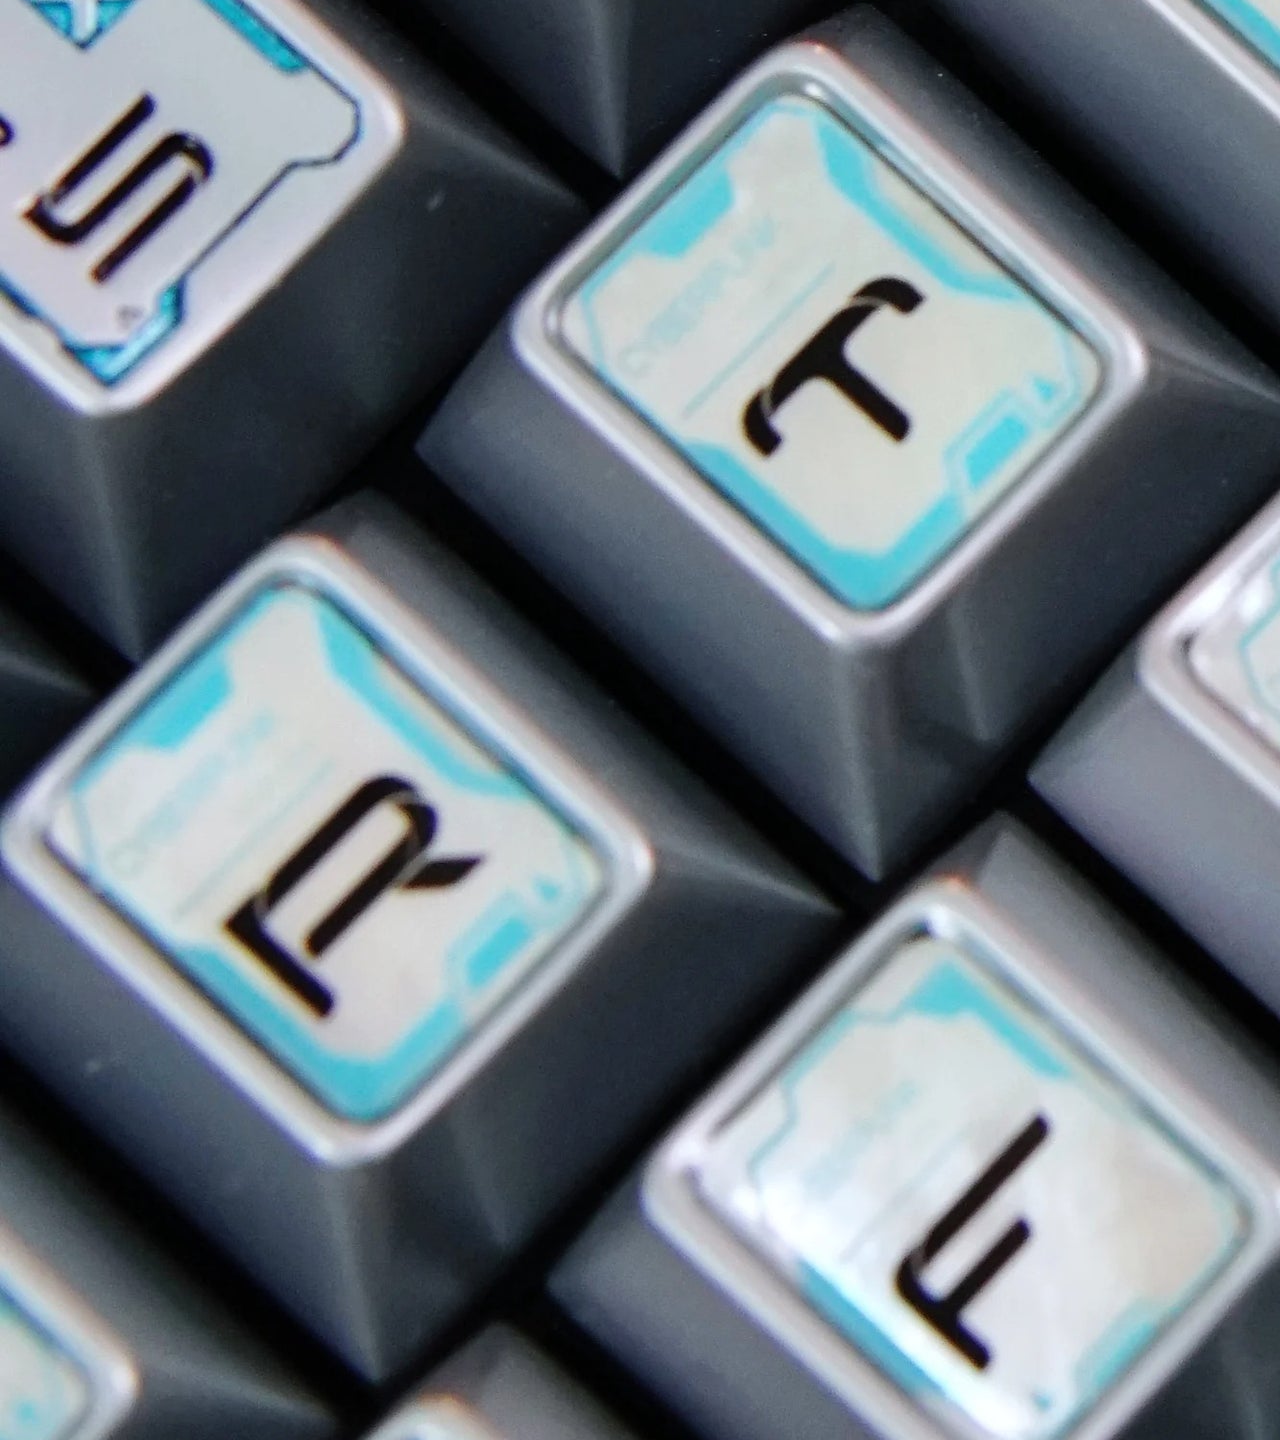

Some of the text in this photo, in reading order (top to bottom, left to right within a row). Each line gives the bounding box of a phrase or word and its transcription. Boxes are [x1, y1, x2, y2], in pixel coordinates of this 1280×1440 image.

[20, 91, 216, 285] 5
[741, 275, 927, 458] T
[222, 772, 490, 1021] R
[892, 1108, 1053, 1373] F
